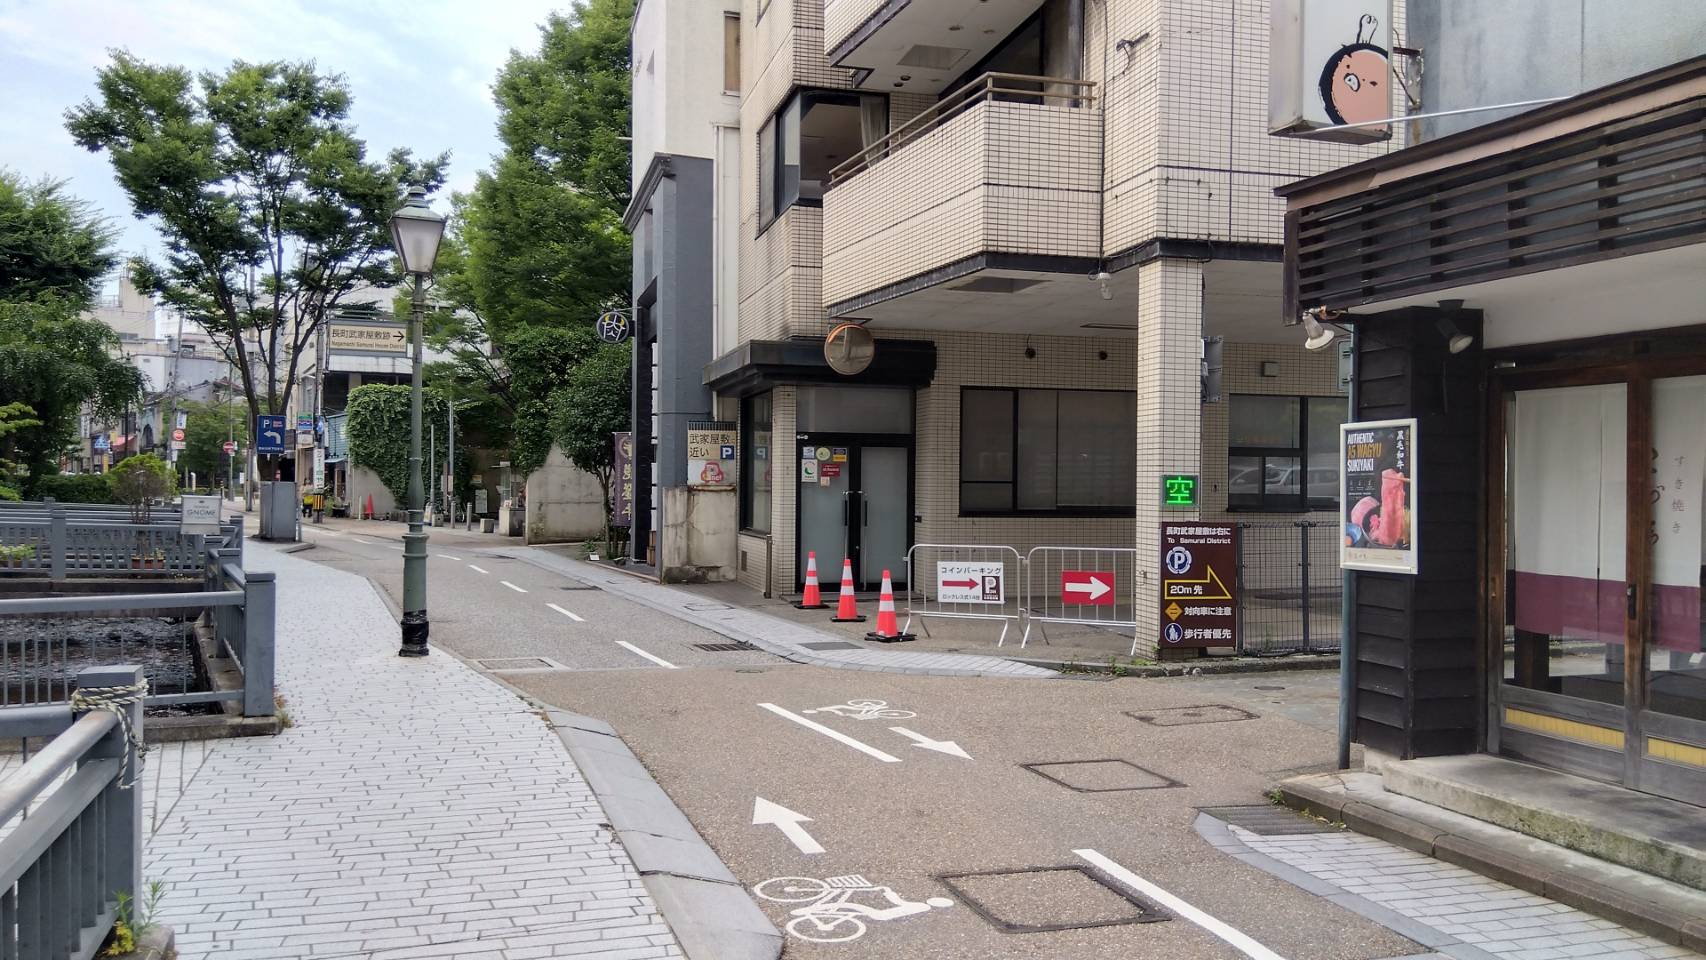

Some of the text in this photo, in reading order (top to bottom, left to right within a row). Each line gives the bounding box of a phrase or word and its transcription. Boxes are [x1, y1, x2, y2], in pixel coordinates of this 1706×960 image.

[332, 328, 391, 340] 長町武家屋敷跡
[263, 420, 270, 428] P
[1347, 432, 1374, 444] AUTHENTIC
[689, 446, 710, 458] 近い
[722, 447, 732, 459] P
[1348, 442, 1382, 458] A5 WAGYU
[1396, 430, 1405, 470] 黒毛和牛
[1347, 459, 1374, 472] SUKIYAKI
[1166, 476, 1193, 504] 空
[1166, 526, 1231, 536] 長町武家屋敷は右に
[1174, 552, 1186, 569] P
[1170, 584, 1203, 595] 20m 先
[1184, 606, 1232, 616] 対向車に注意
[1184, 628, 1232, 640] 歩行者優先
